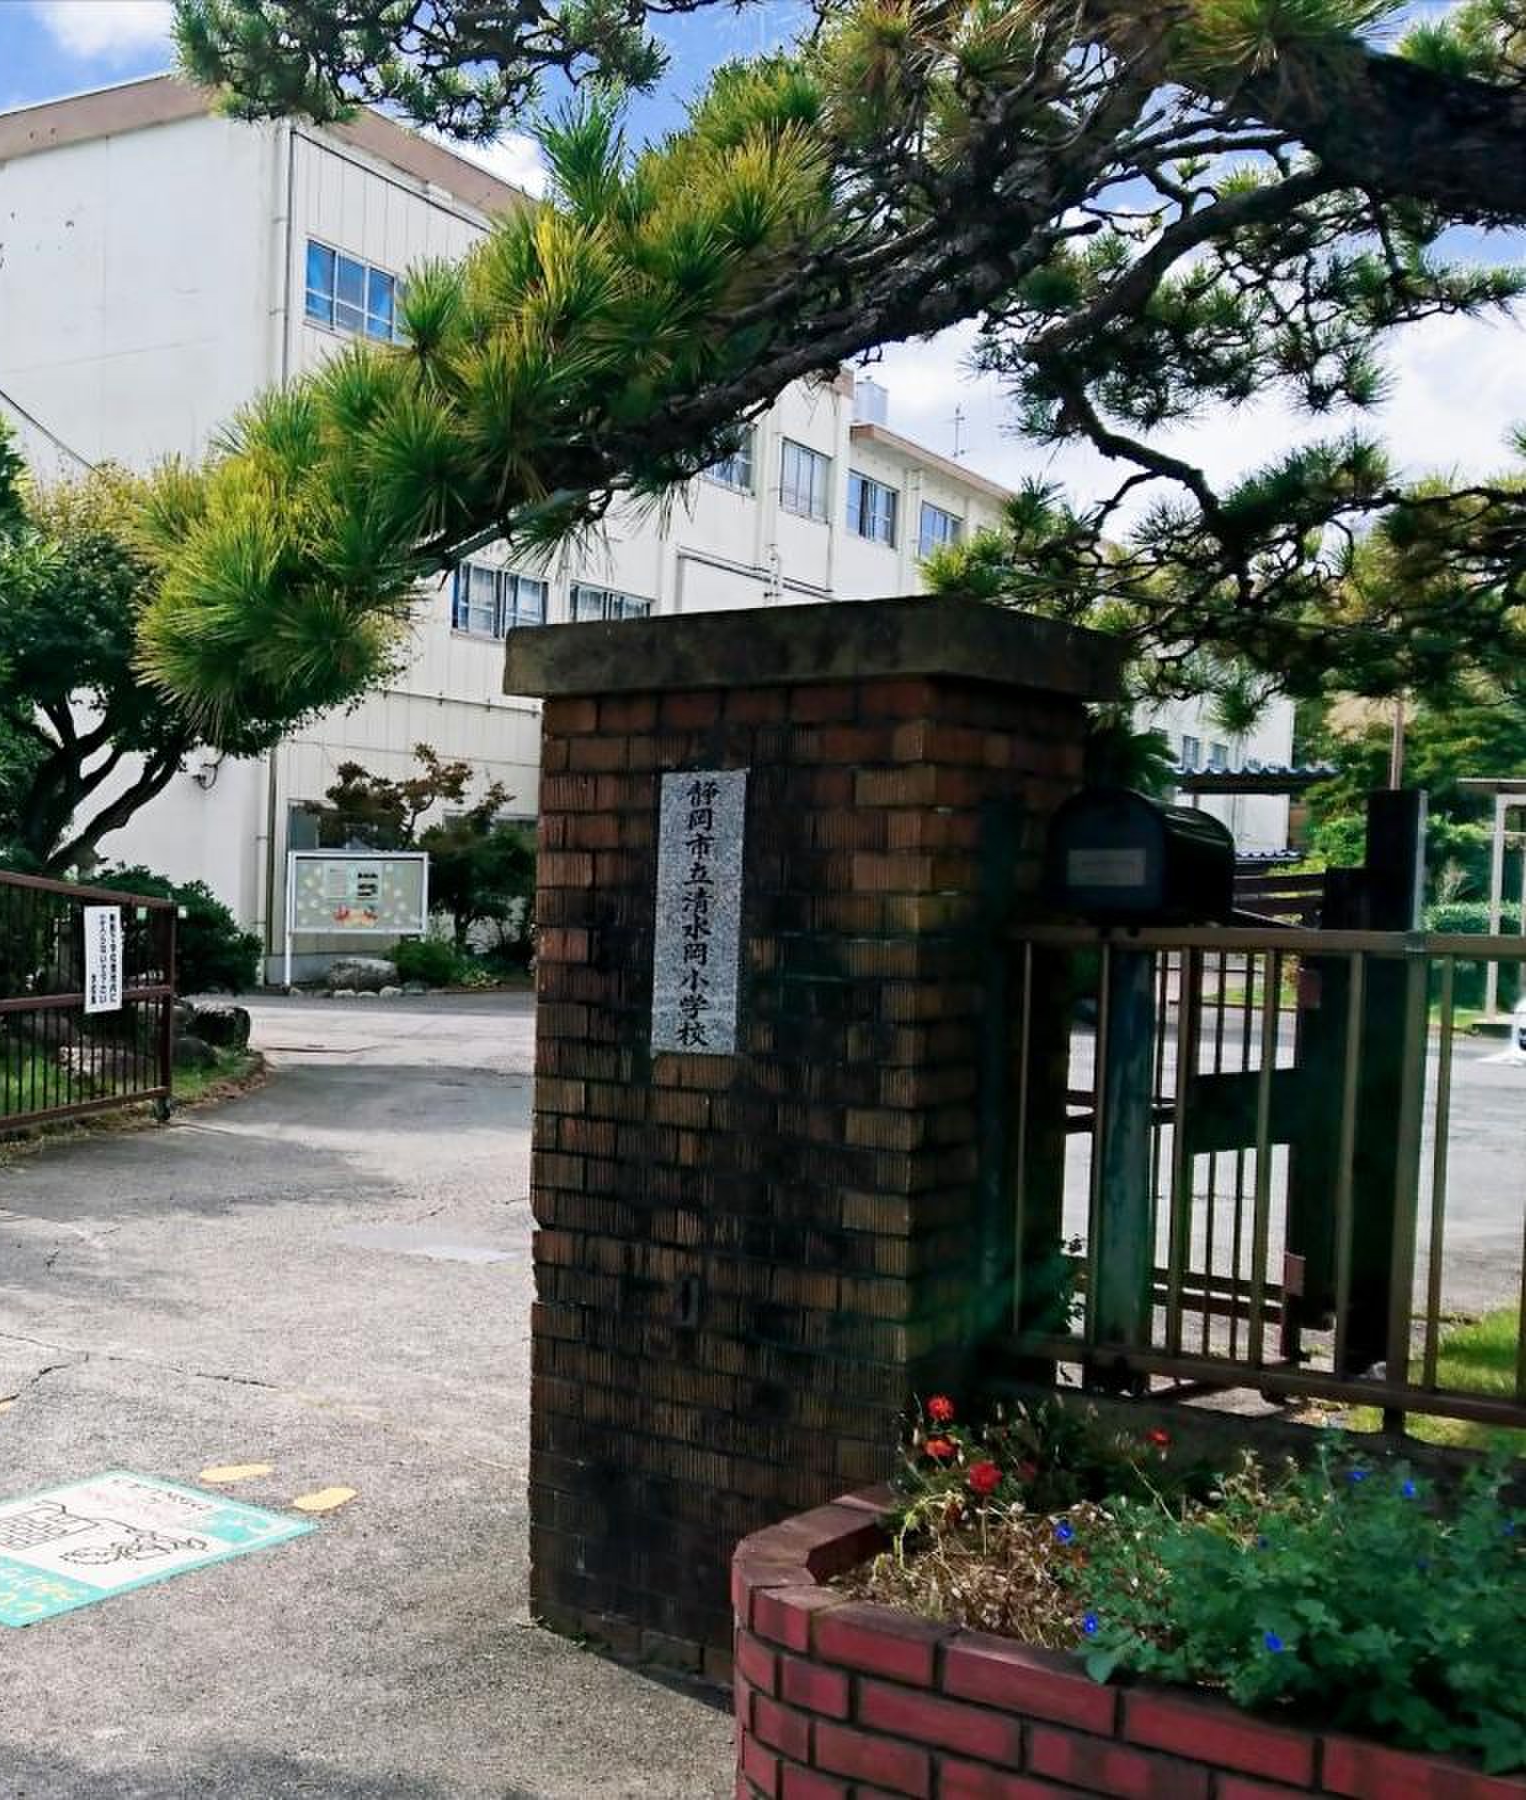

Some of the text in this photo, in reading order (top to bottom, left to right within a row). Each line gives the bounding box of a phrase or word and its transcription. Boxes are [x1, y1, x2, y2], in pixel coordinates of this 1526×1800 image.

[675, 779, 721, 1047] 静岡市立清水岡小学校
